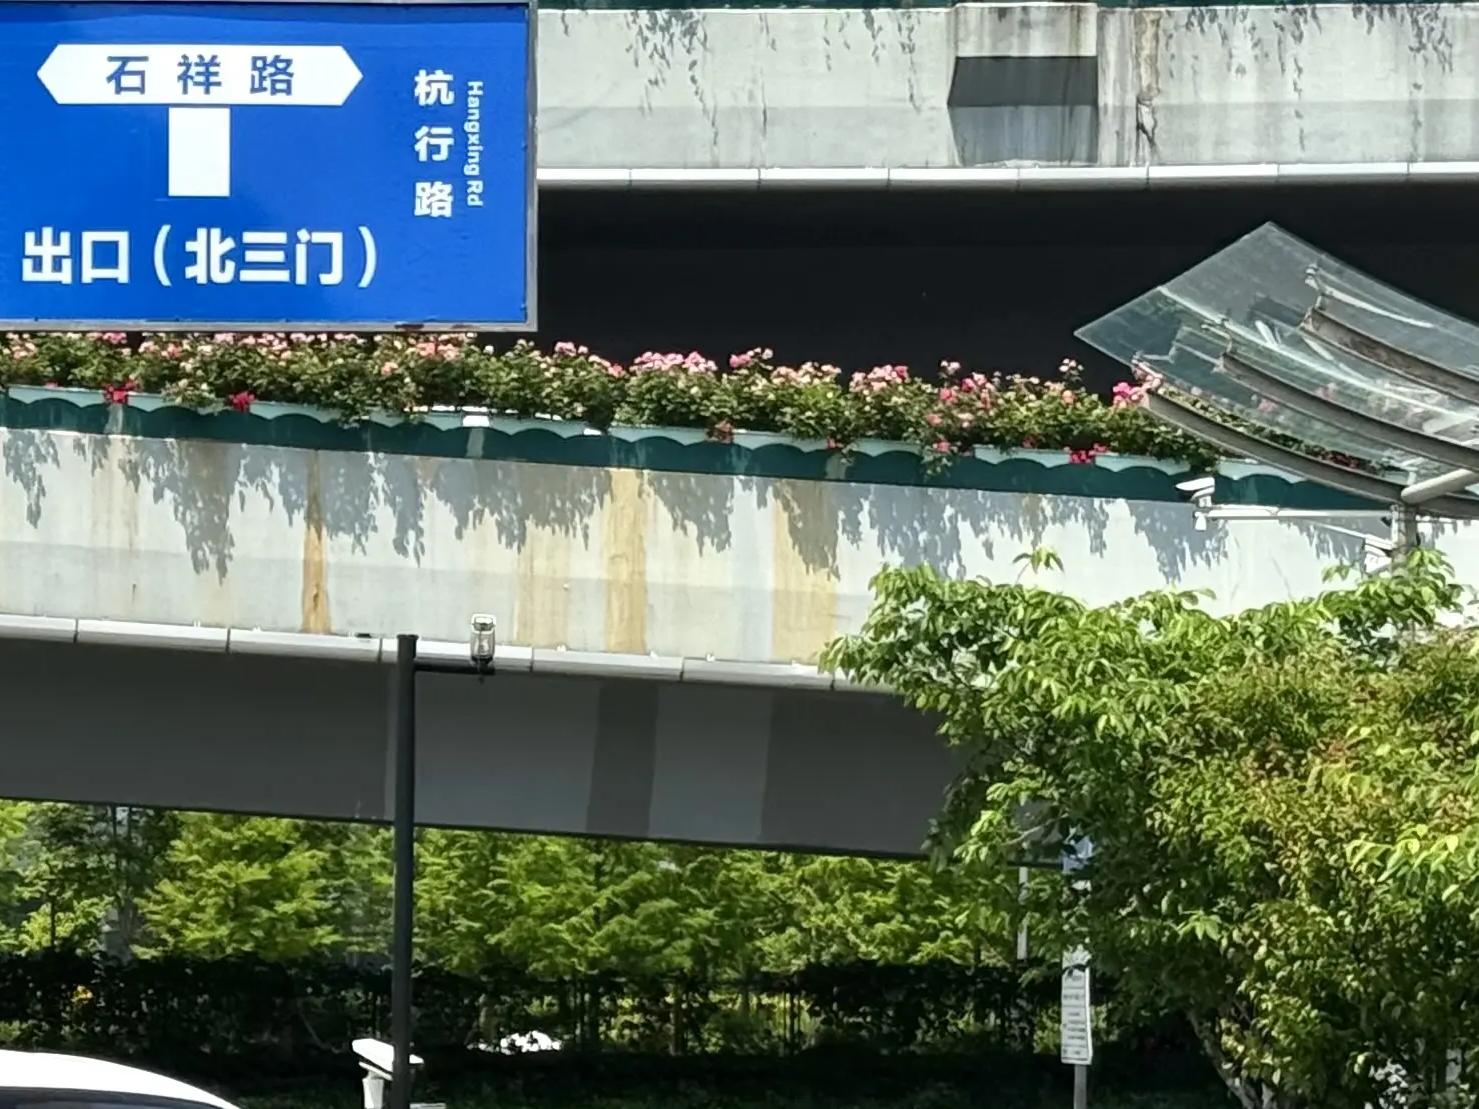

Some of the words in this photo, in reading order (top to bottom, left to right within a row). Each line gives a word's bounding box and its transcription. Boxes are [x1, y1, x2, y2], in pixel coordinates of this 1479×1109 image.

[105, 54, 295, 96] 石祥路
[413, 69, 455, 218] 杭行路
[463, 81, 484, 176] Hangxing
[466, 180, 484, 206] Rd
